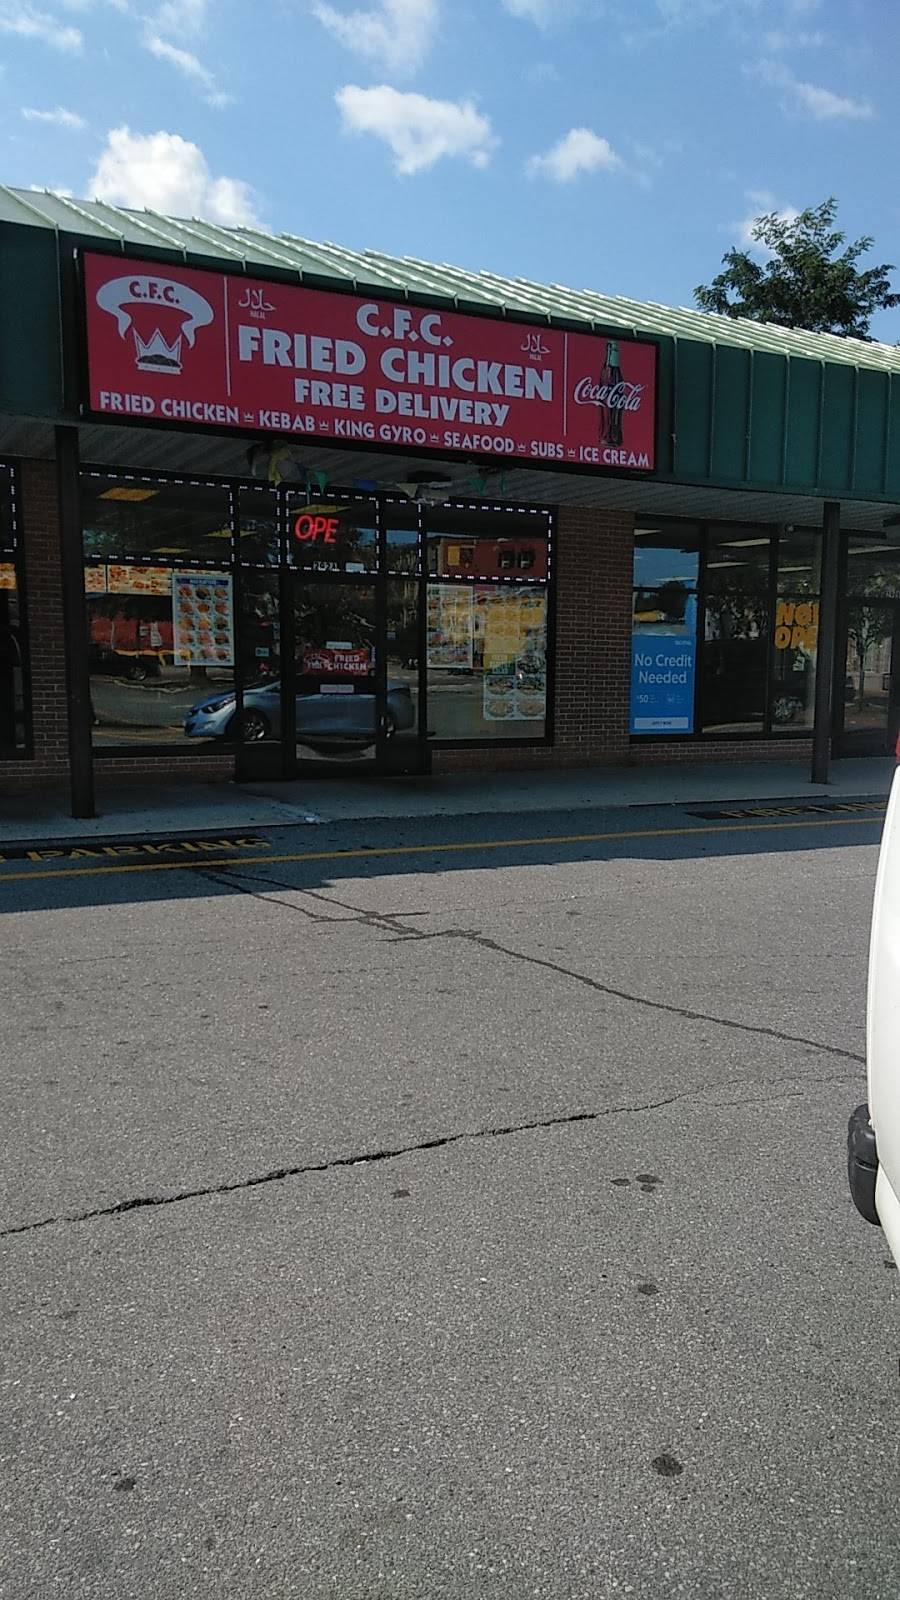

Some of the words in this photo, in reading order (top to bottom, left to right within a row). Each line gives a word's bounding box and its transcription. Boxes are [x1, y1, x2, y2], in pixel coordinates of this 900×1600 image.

[129, 281, 180, 304] C.F.C.
[356, 303, 454, 347] C.F.C.
[237, 324, 367, 376] FRIED
[380, 347, 553, 401] CHICKEN
[294, 377, 366, 410] FREE
[375, 388, 510, 427] DELIVERY
[573, 376, 647, 412] Coca-Cola
[99, 391, 155, 414] FRIED
[161, 399, 239, 424] CHICKEN
[259, 410, 316, 432] KEBAB
[334, 418, 375, 439] KING
[379, 424, 426, 444] GYRO
[443, 432, 514, 453] SEAFOOD
[530, 441, 564, 458] SUBS
[579, 446, 599, 462] ICE
[603, 448, 649, 467] CREAM
[634, 653, 653, 667] No
[655, 654, 692, 668] Credit
[639, 671, 688, 684] Needed
[27, 838, 273, 862] PARKING
